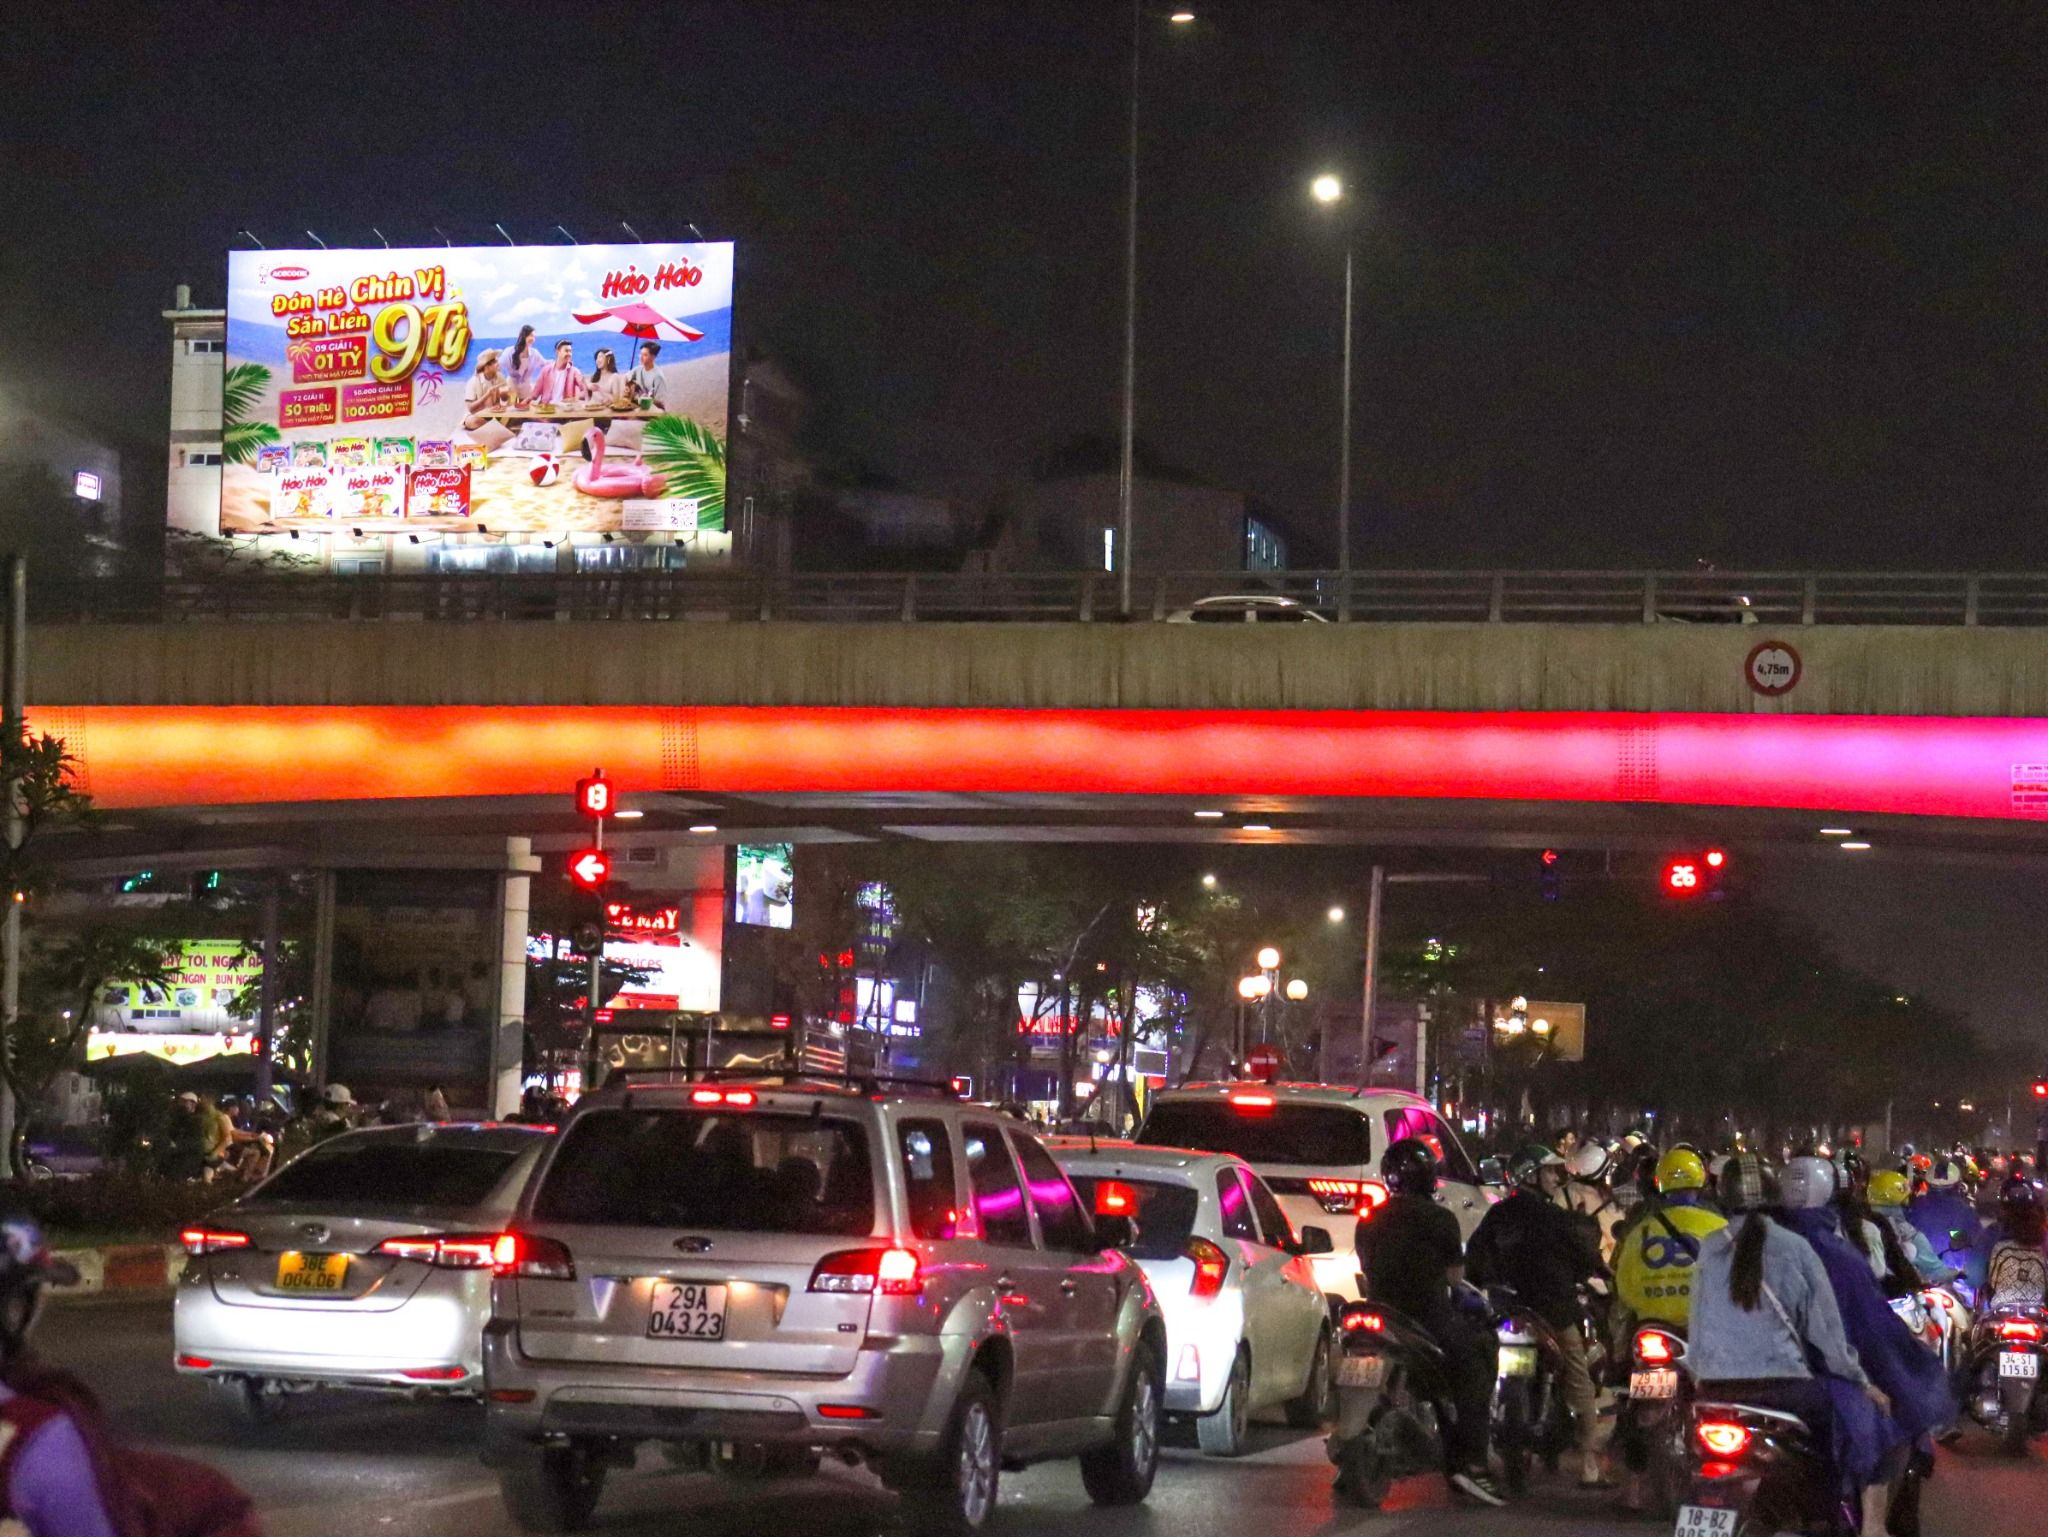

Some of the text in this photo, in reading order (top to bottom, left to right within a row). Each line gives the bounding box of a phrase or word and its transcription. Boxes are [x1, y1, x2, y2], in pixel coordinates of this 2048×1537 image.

[601, 256, 703, 299] Hảo Hảo
[272, 265, 445, 317] Đón Hè Chín Vị
[315, 353, 333, 369] 01
[669, 1286, 708, 1311] 29A
[650, 1311, 722, 1336] 043.23
